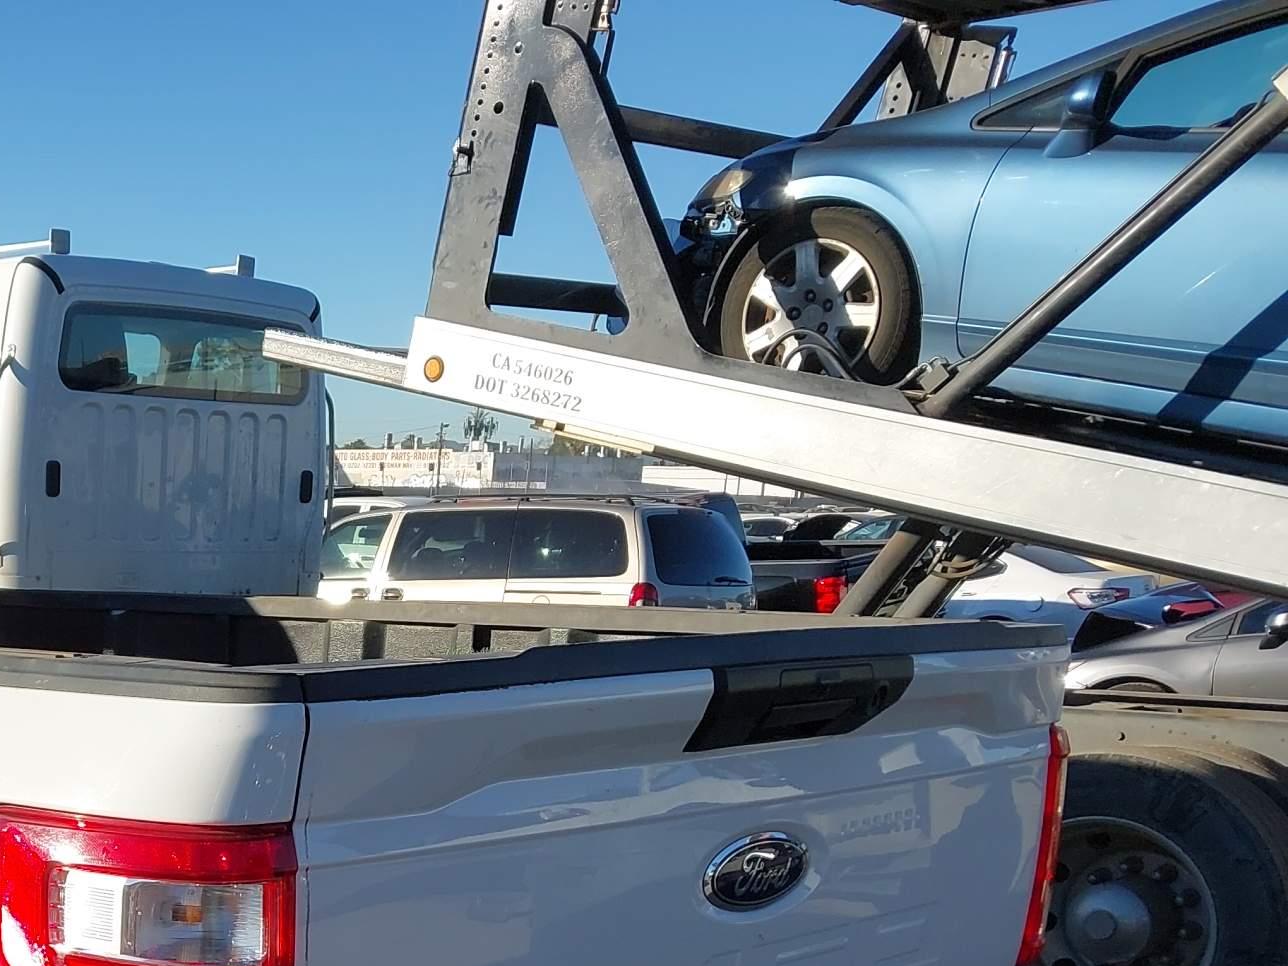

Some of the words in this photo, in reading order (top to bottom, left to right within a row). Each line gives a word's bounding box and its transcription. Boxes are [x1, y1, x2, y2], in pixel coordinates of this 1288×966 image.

[513, 359, 574, 386] 546026
[474, 374, 507, 395] DOT
[510, 382, 582, 412] 3268272
[391, 452, 450, 461] PARTS-RADIATRS
[735, 849, 793, 897] Ford
